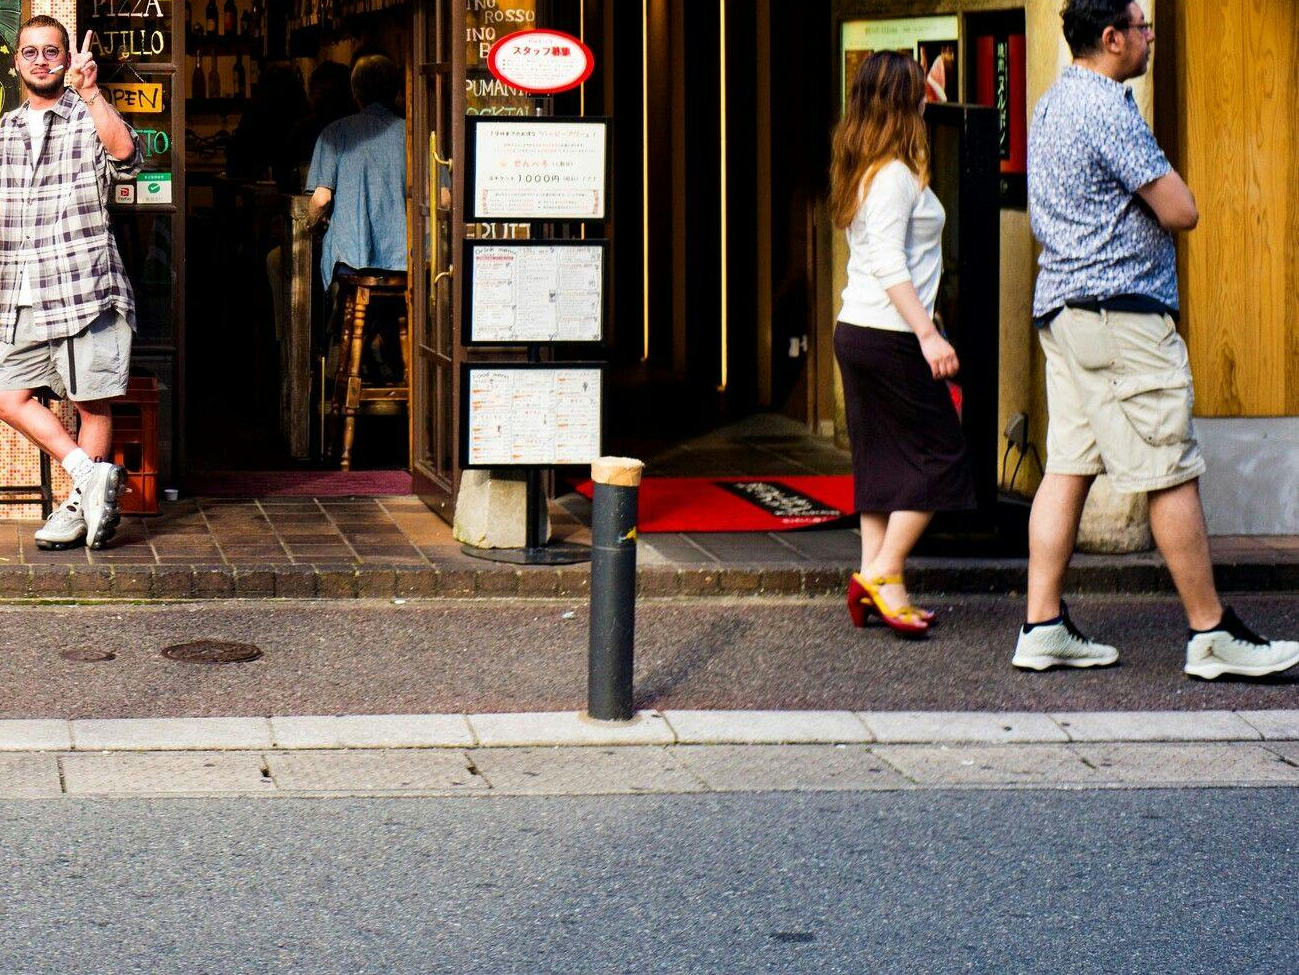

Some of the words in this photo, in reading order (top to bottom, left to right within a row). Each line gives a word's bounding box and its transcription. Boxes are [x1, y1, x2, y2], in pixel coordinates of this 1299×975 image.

[484, 9, 535, 24] ROSSO
[466, 27, 496, 42] INO
[111, 88, 159, 109] PEN
